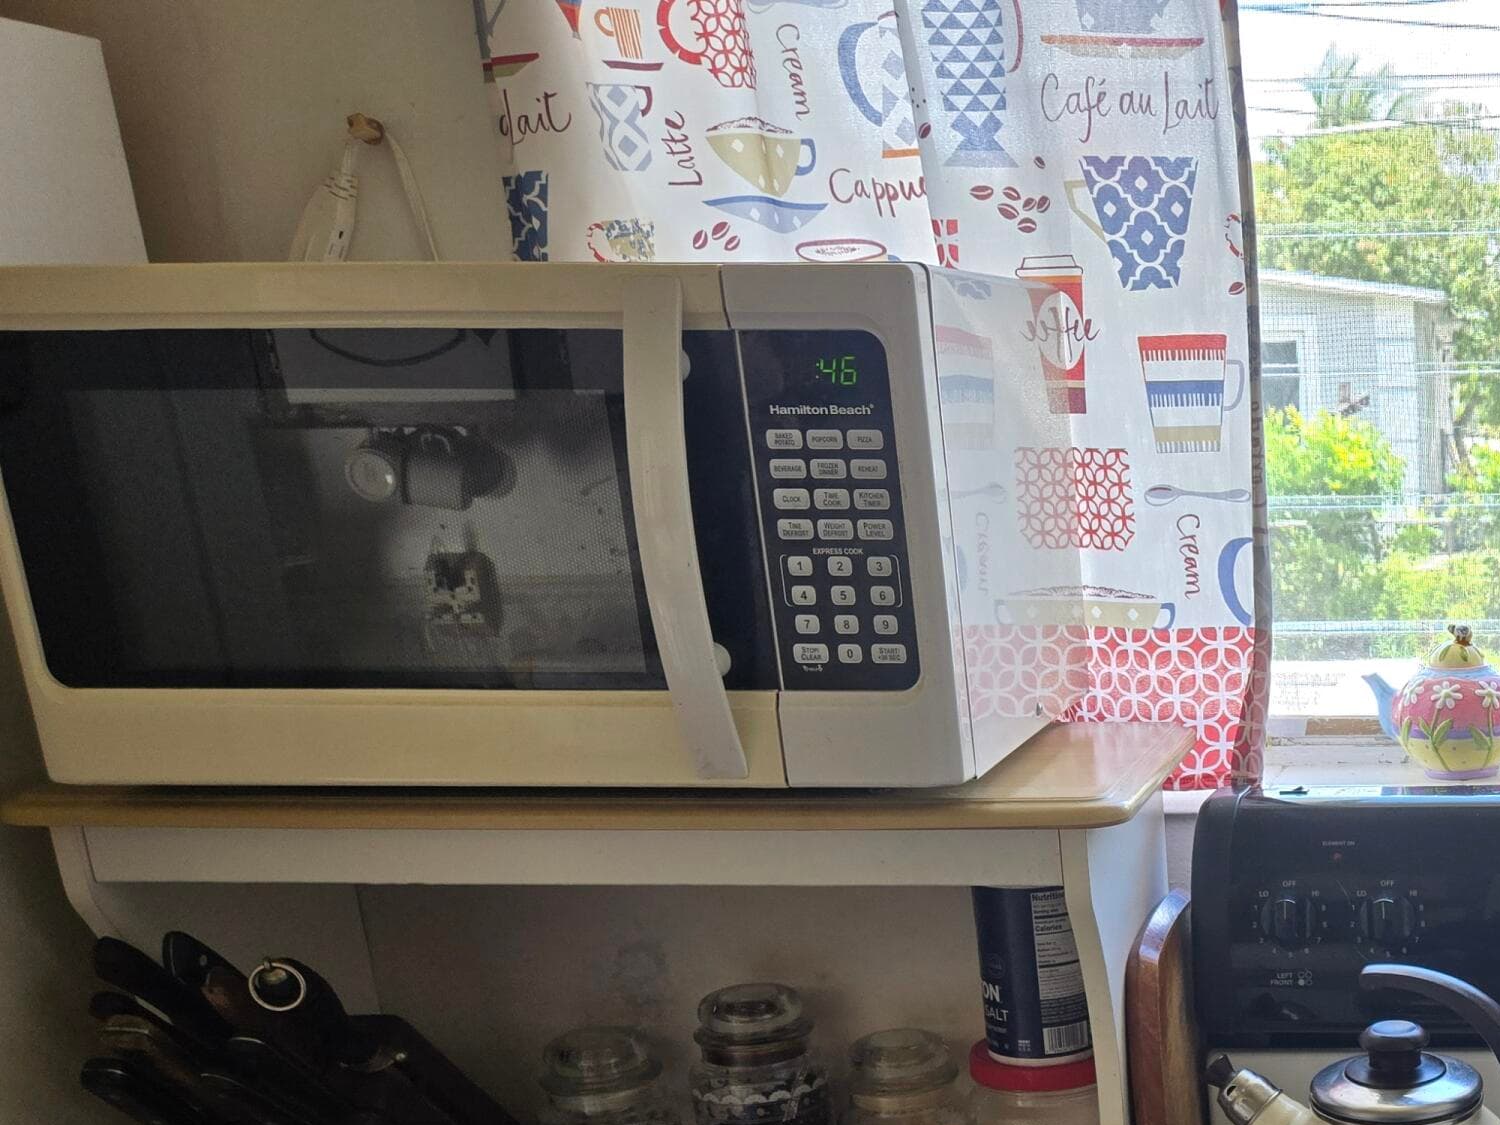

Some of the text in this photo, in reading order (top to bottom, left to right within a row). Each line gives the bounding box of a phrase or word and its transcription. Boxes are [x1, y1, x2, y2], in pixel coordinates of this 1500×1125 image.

[776, 23, 810, 121] Cream
[1041, 71, 1219, 143] Café au Lait
[661, 110, 703, 186] Latte
[769, 404, 829, 416] Hamilton
[812, 547, 842, 555] EXPRESS
[1176, 514, 1201, 600] Cream
[797, 561, 803, 571] 1
[836, 561, 843, 571] 2
[876, 561, 883, 571] 3
[800, 591, 807, 600] 4
[840, 591, 847, 600] 5
[879, 591, 886, 600] 6
[804, 620, 810, 629] 7
[843, 620, 850, 629] 8
[882, 620, 889, 629] 9
[847, 649, 853, 658] 0
[1035, 924, 1062, 933] Calories
[982, 981, 1001, 1003] ON
